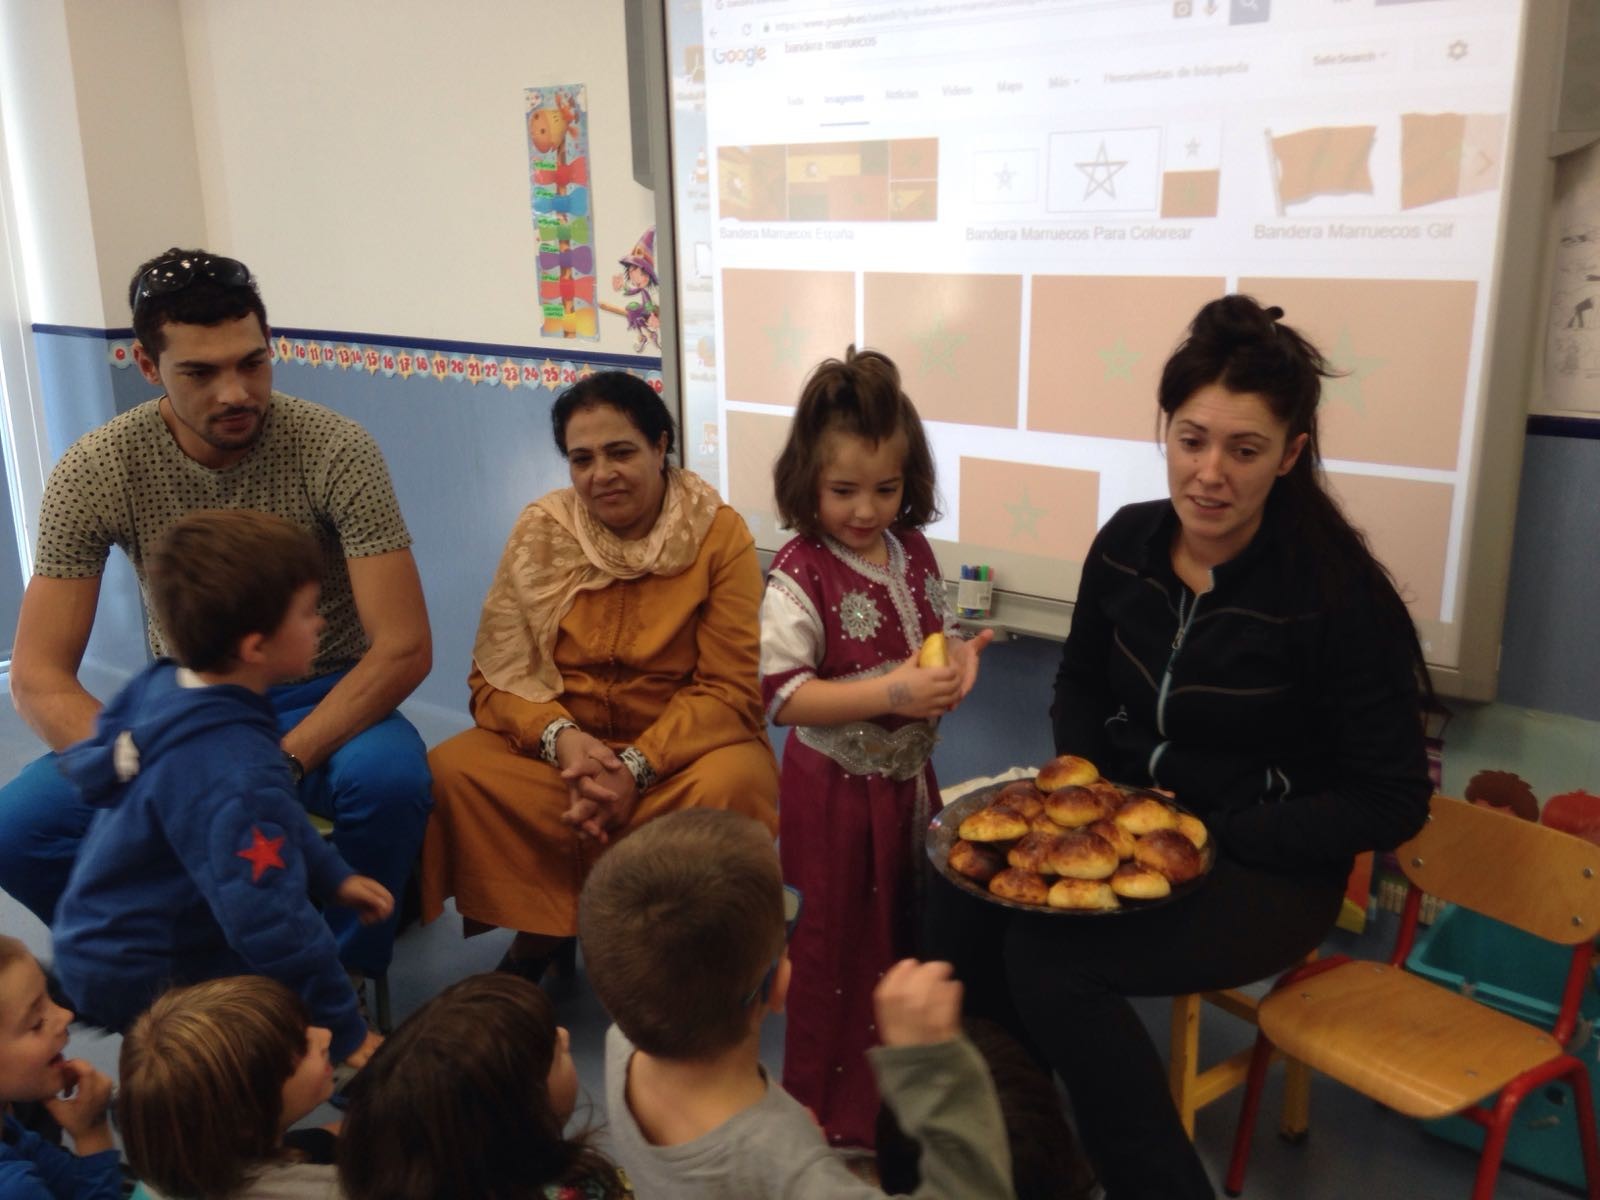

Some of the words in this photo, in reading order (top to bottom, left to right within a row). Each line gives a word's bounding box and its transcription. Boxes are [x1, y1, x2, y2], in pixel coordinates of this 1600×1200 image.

[784, 41, 823, 54] bandera
[825, 36, 877, 49] marruecos
[712, 45, 767, 67] Google
[719, 227, 759, 240] Bandera
[761, 227, 812, 240] Marruecos
[815, 227, 854, 242] España
[965, 227, 1017, 241] Bandera
[1020, 227, 1089, 241] Marruecos
[1093, 226, 1126, 240] Para
[1130, 225, 1193, 240] Colorear
[1254, 224, 1323, 240] Bandera
[1328, 223, 1421, 239] Marruecos
[1427, 221, 1455, 239] Gif
[295, 345, 305, 359] 10
[310, 347, 319, 361] 11
[323, 347, 334, 361] 12
[339, 349, 350, 363] 13
[350, 350, 362, 364] 14
[366, 351, 378, 367] 15
[383, 355, 394, 370] 16
[400, 357, 410, 372] 17
[416, 356, 428, 371] 18
[434, 359, 446, 374] 19
[451, 359, 464, 374] 20
[468, 362, 480, 377] 21
[484, 363, 498, 377] 22
[504, 367, 518, 382] 23
[524, 367, 539, 381] 24
[544, 367, 559, 382] 25
